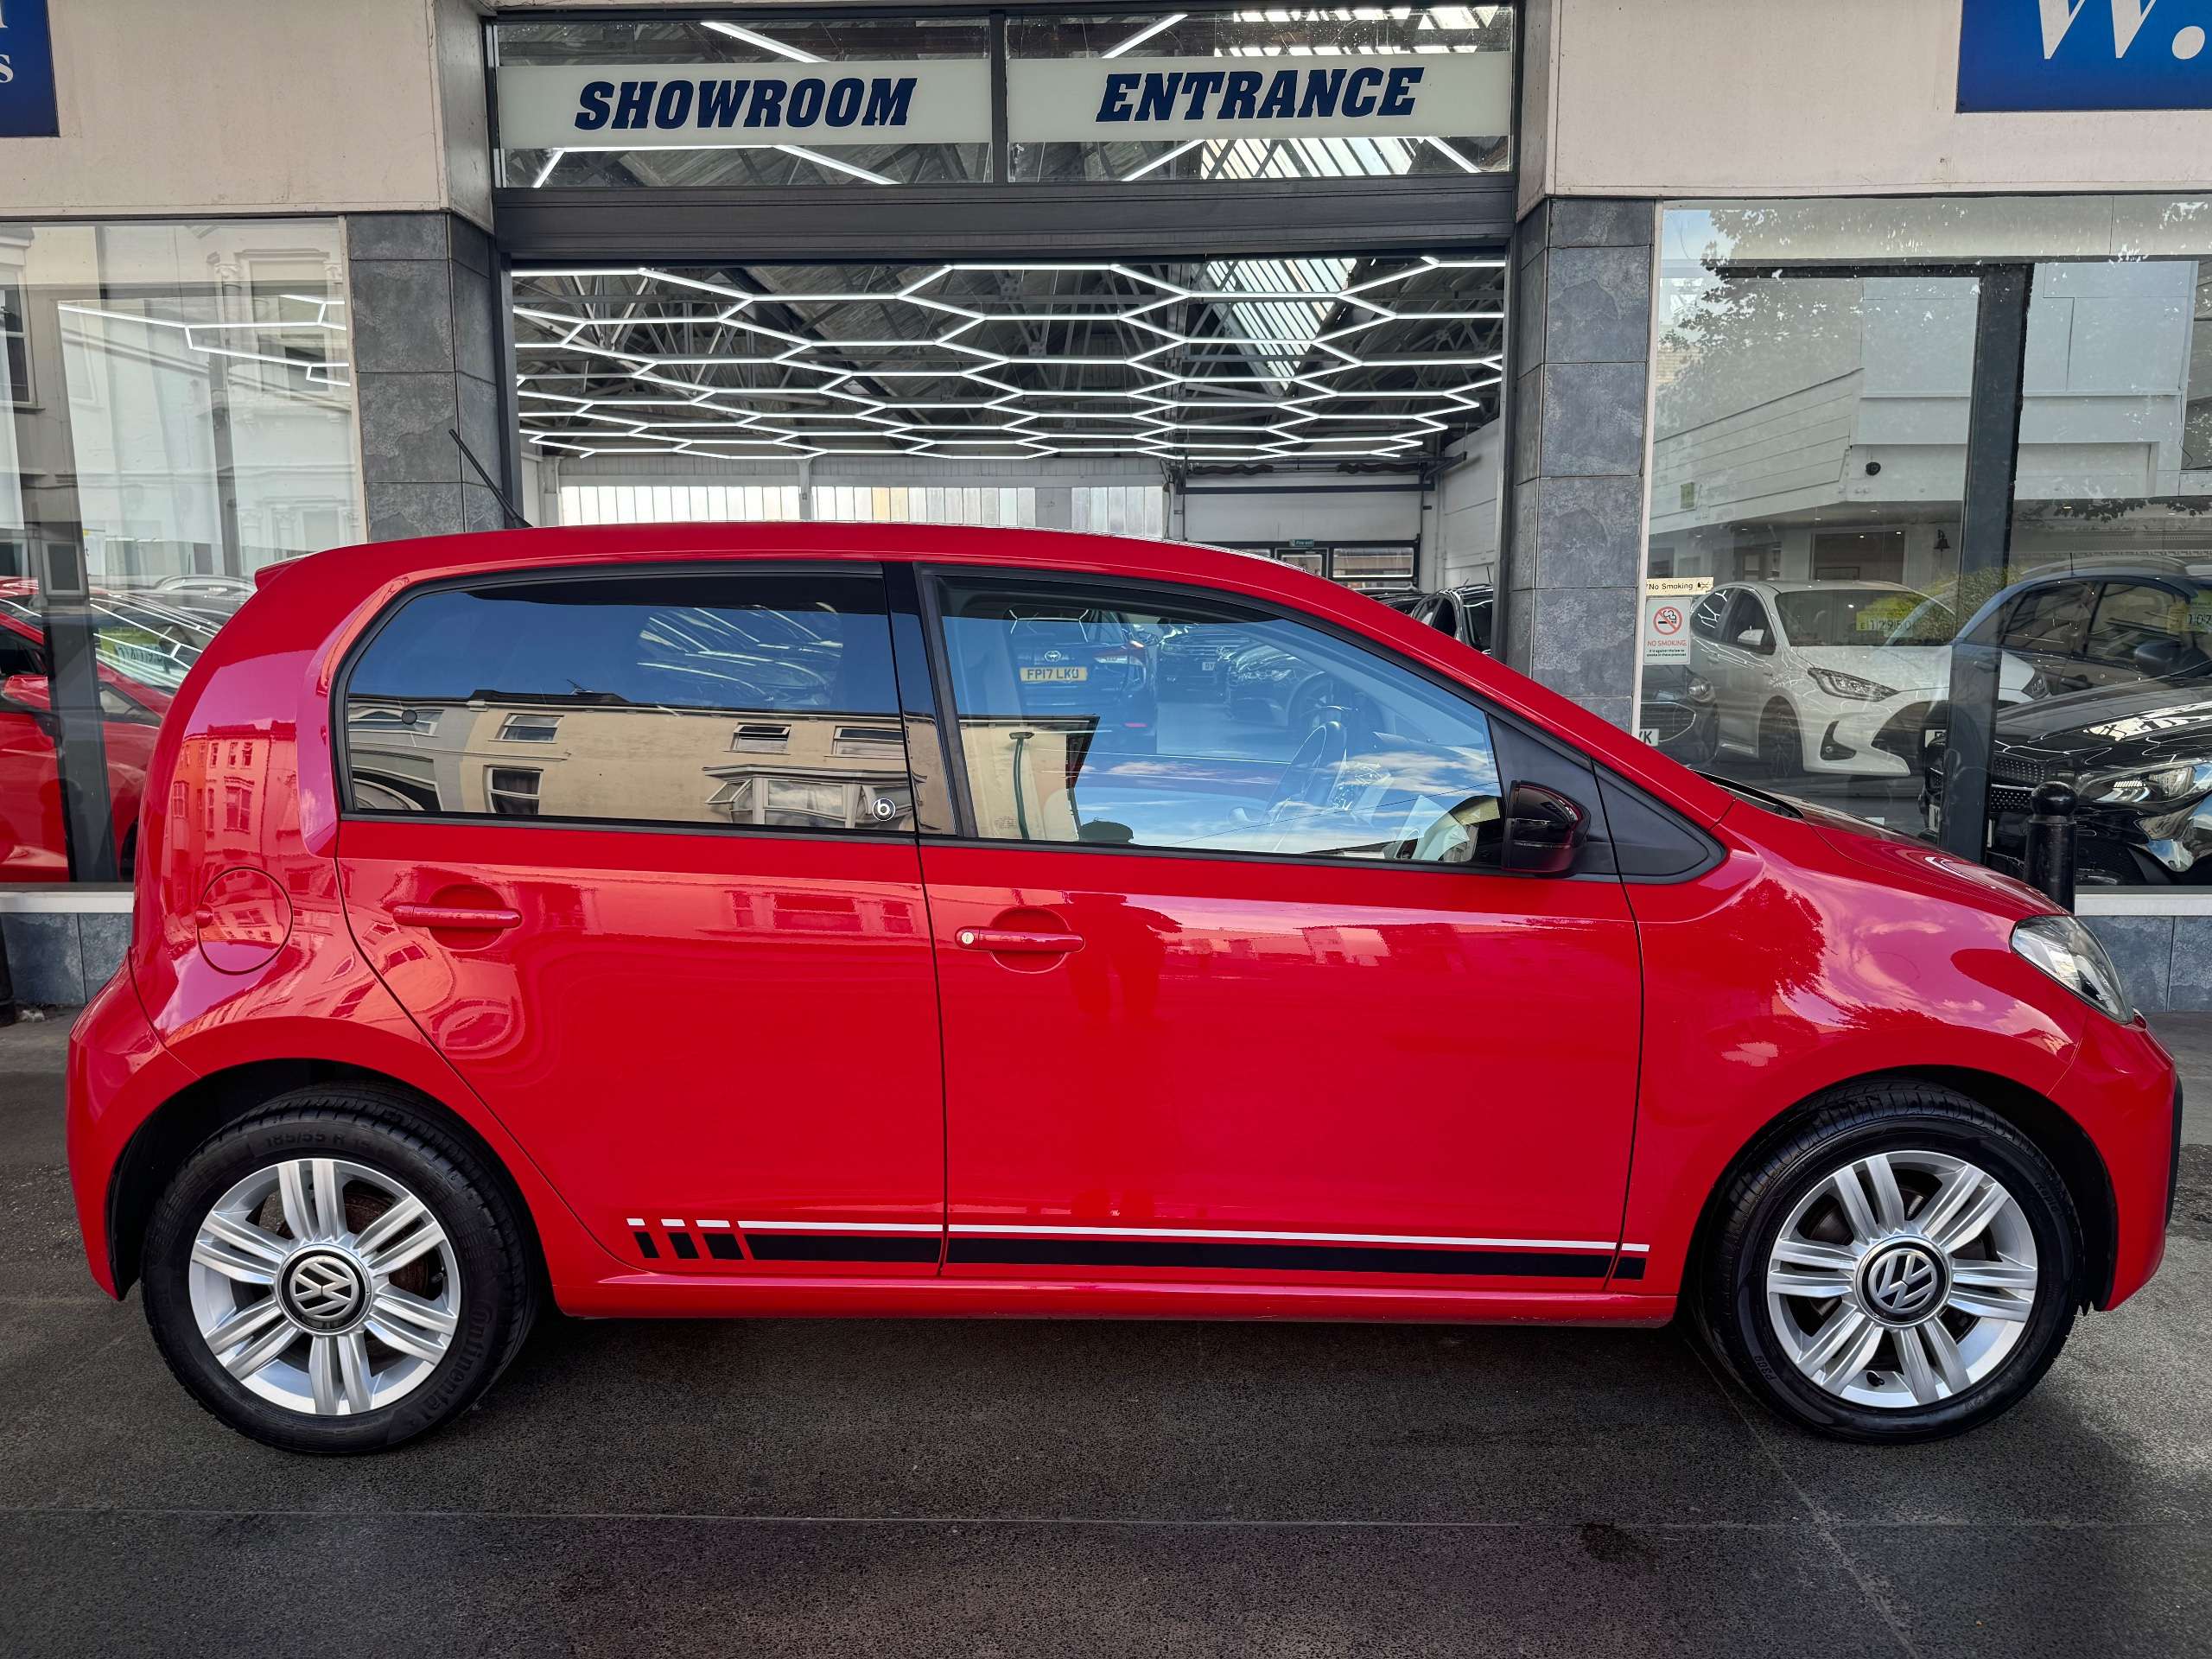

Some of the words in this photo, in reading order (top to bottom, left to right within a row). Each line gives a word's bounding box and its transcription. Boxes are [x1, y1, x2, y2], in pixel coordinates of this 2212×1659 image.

[574, 78, 918, 130] SHOWROOM
[1096, 67, 1425, 123] ENTRANCE
[1027, 669, 1053, 680] FP17
[1057, 669, 1079, 679] LKU
